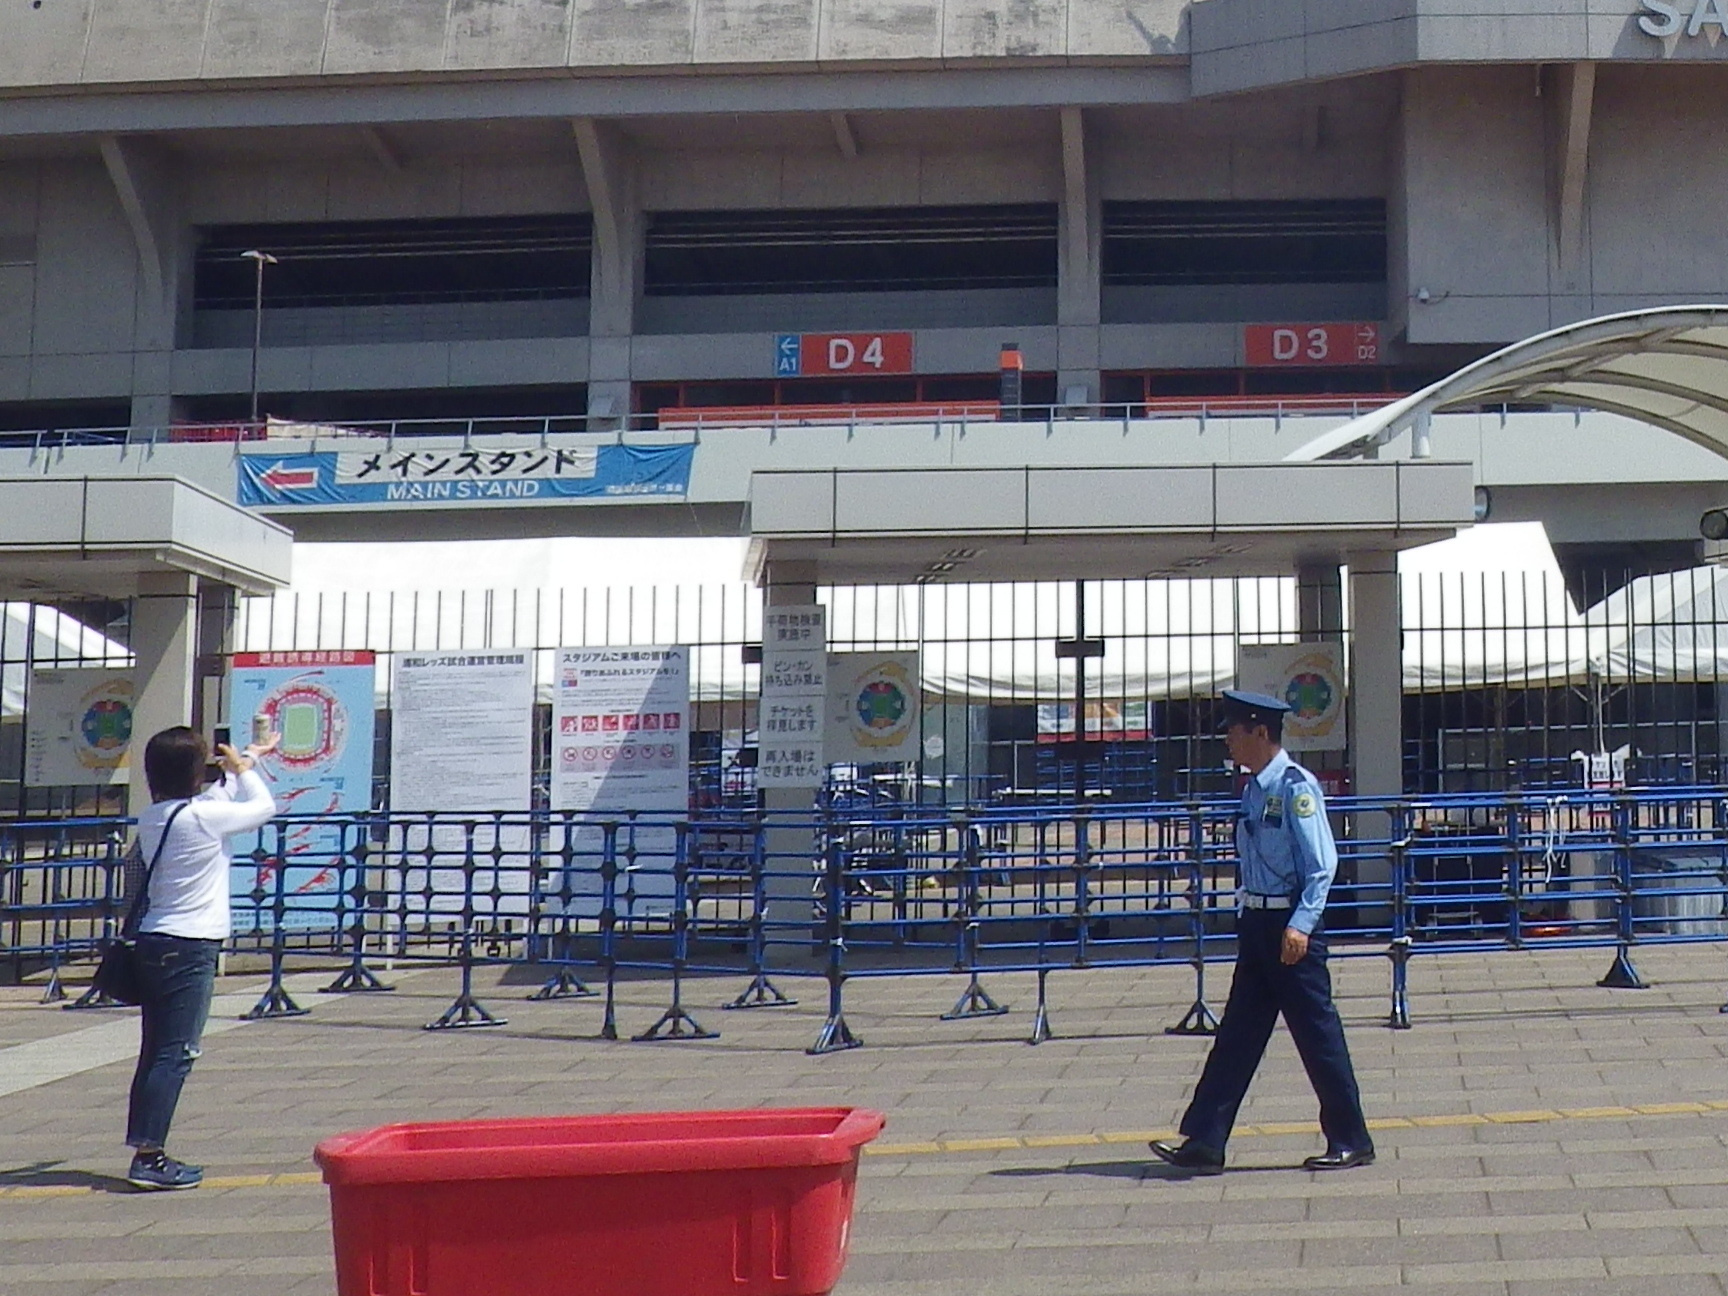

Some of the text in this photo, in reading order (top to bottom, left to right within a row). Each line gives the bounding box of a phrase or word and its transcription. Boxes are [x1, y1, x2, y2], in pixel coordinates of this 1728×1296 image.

[829, 337, 884, 369] D4
[1273, 328, 1328, 360] D3
[1357, 345, 1377, 359] D2
[779, 357, 797, 371] A1
[357, 449, 577, 479] メインスタンド
[387, 480, 540, 500] MAIN STAND
